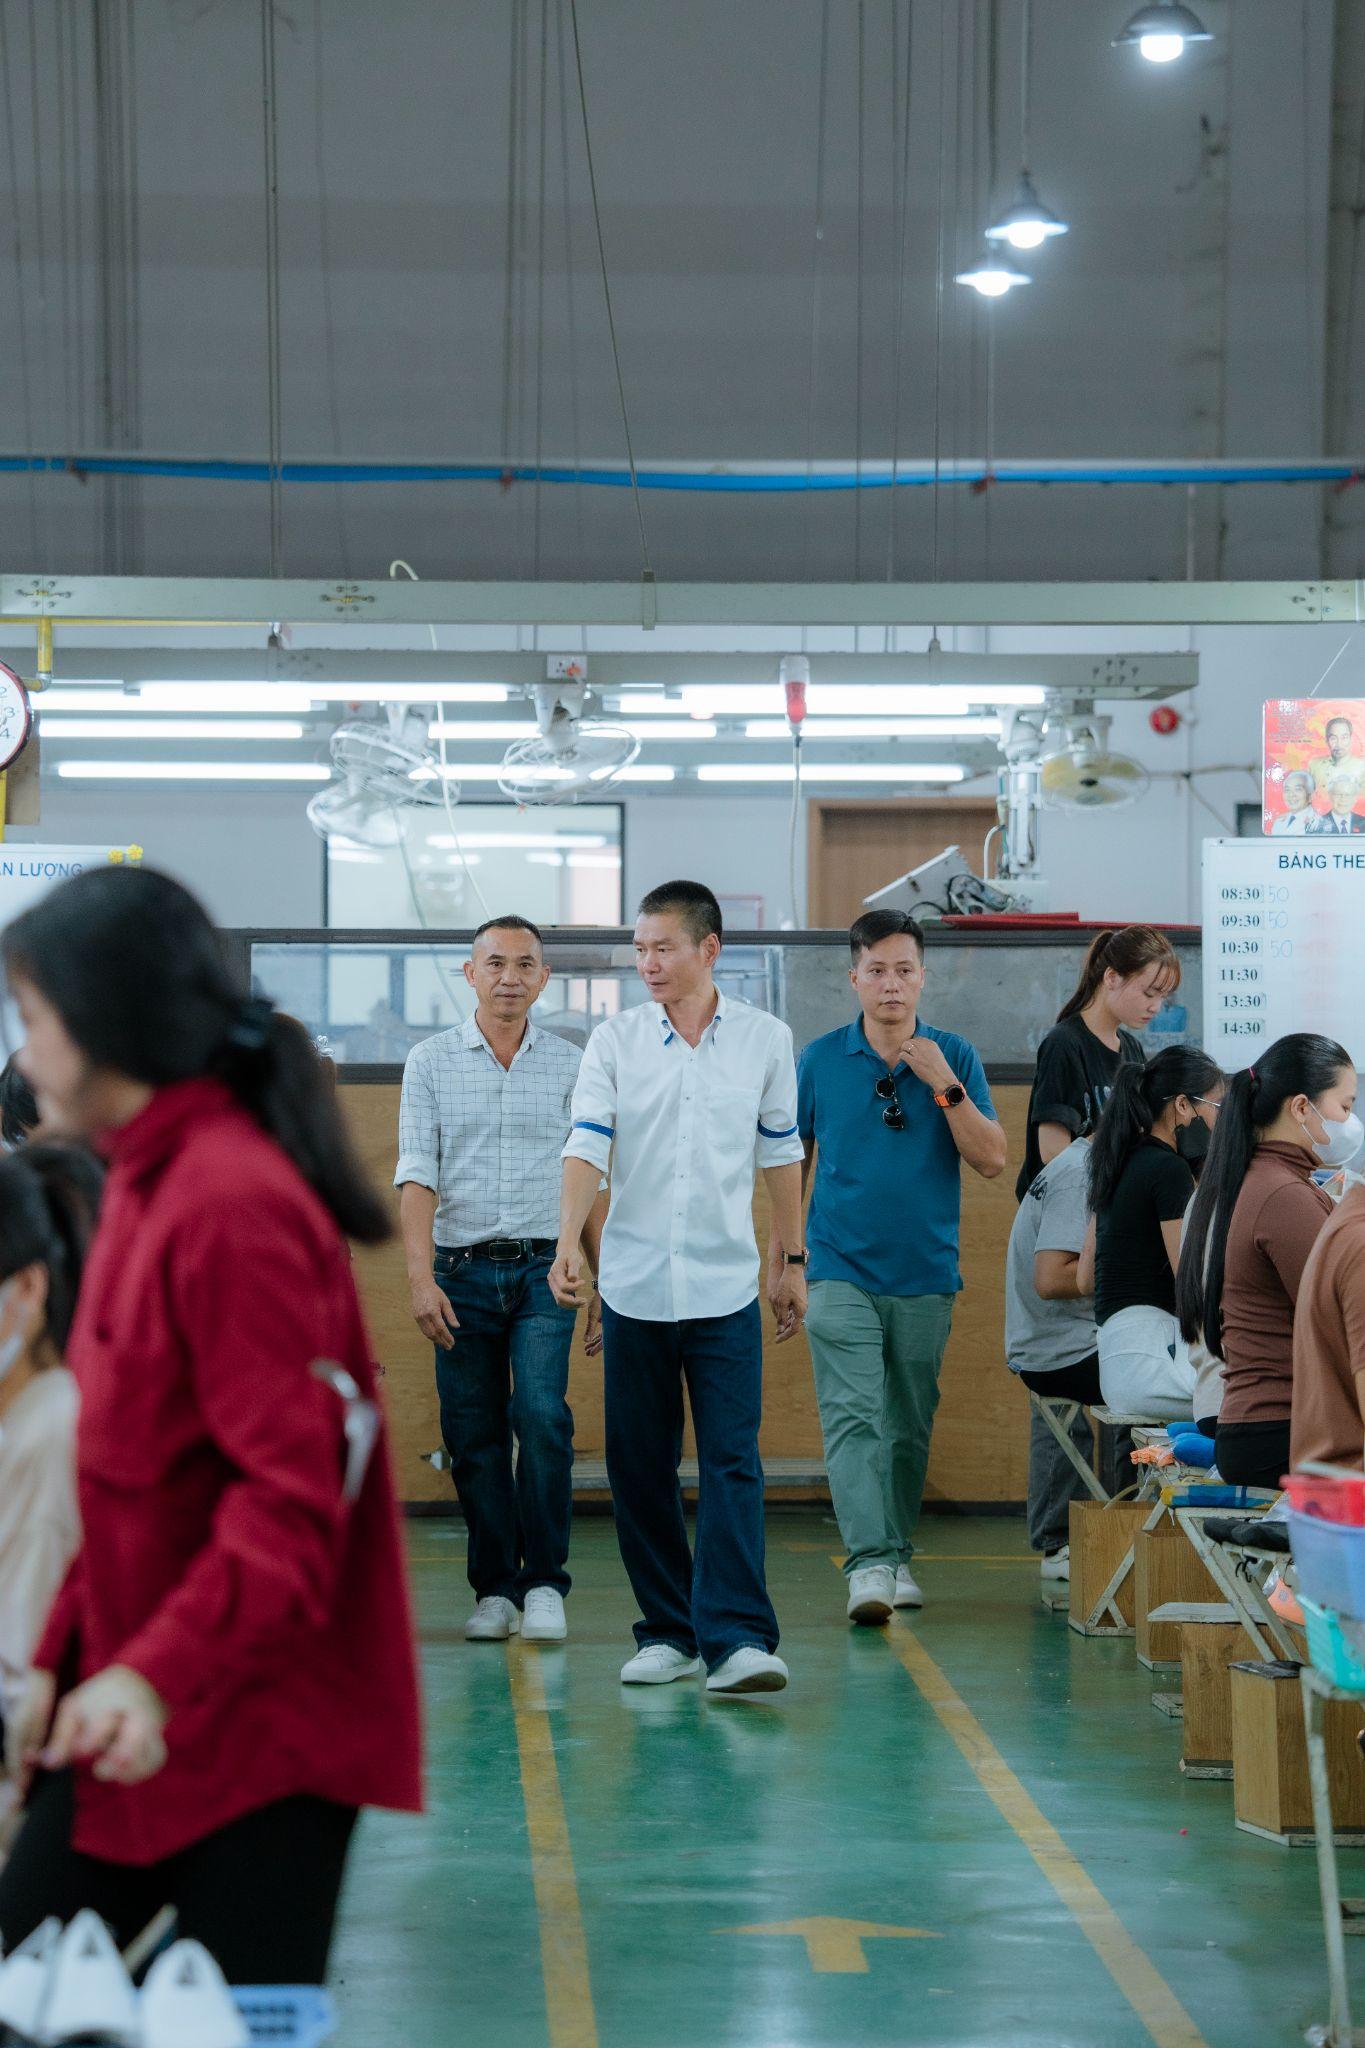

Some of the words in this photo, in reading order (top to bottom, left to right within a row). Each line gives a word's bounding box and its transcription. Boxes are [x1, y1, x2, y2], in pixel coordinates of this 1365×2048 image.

[3, 706, 16, 719] 3
[1278, 851, 1327, 869] BẢNG
[1332, 854, 1365, 869] THE
[1221, 887, 1260, 900] 08:30
[1221, 914, 1260, 928] 09:30
[1221, 941, 1259, 954] 10:30
[1221, 969, 1258, 981] 11:30
[1224, 995, 1261, 1008] 13:30
[1224, 1022, 1261, 1035] 14:30
